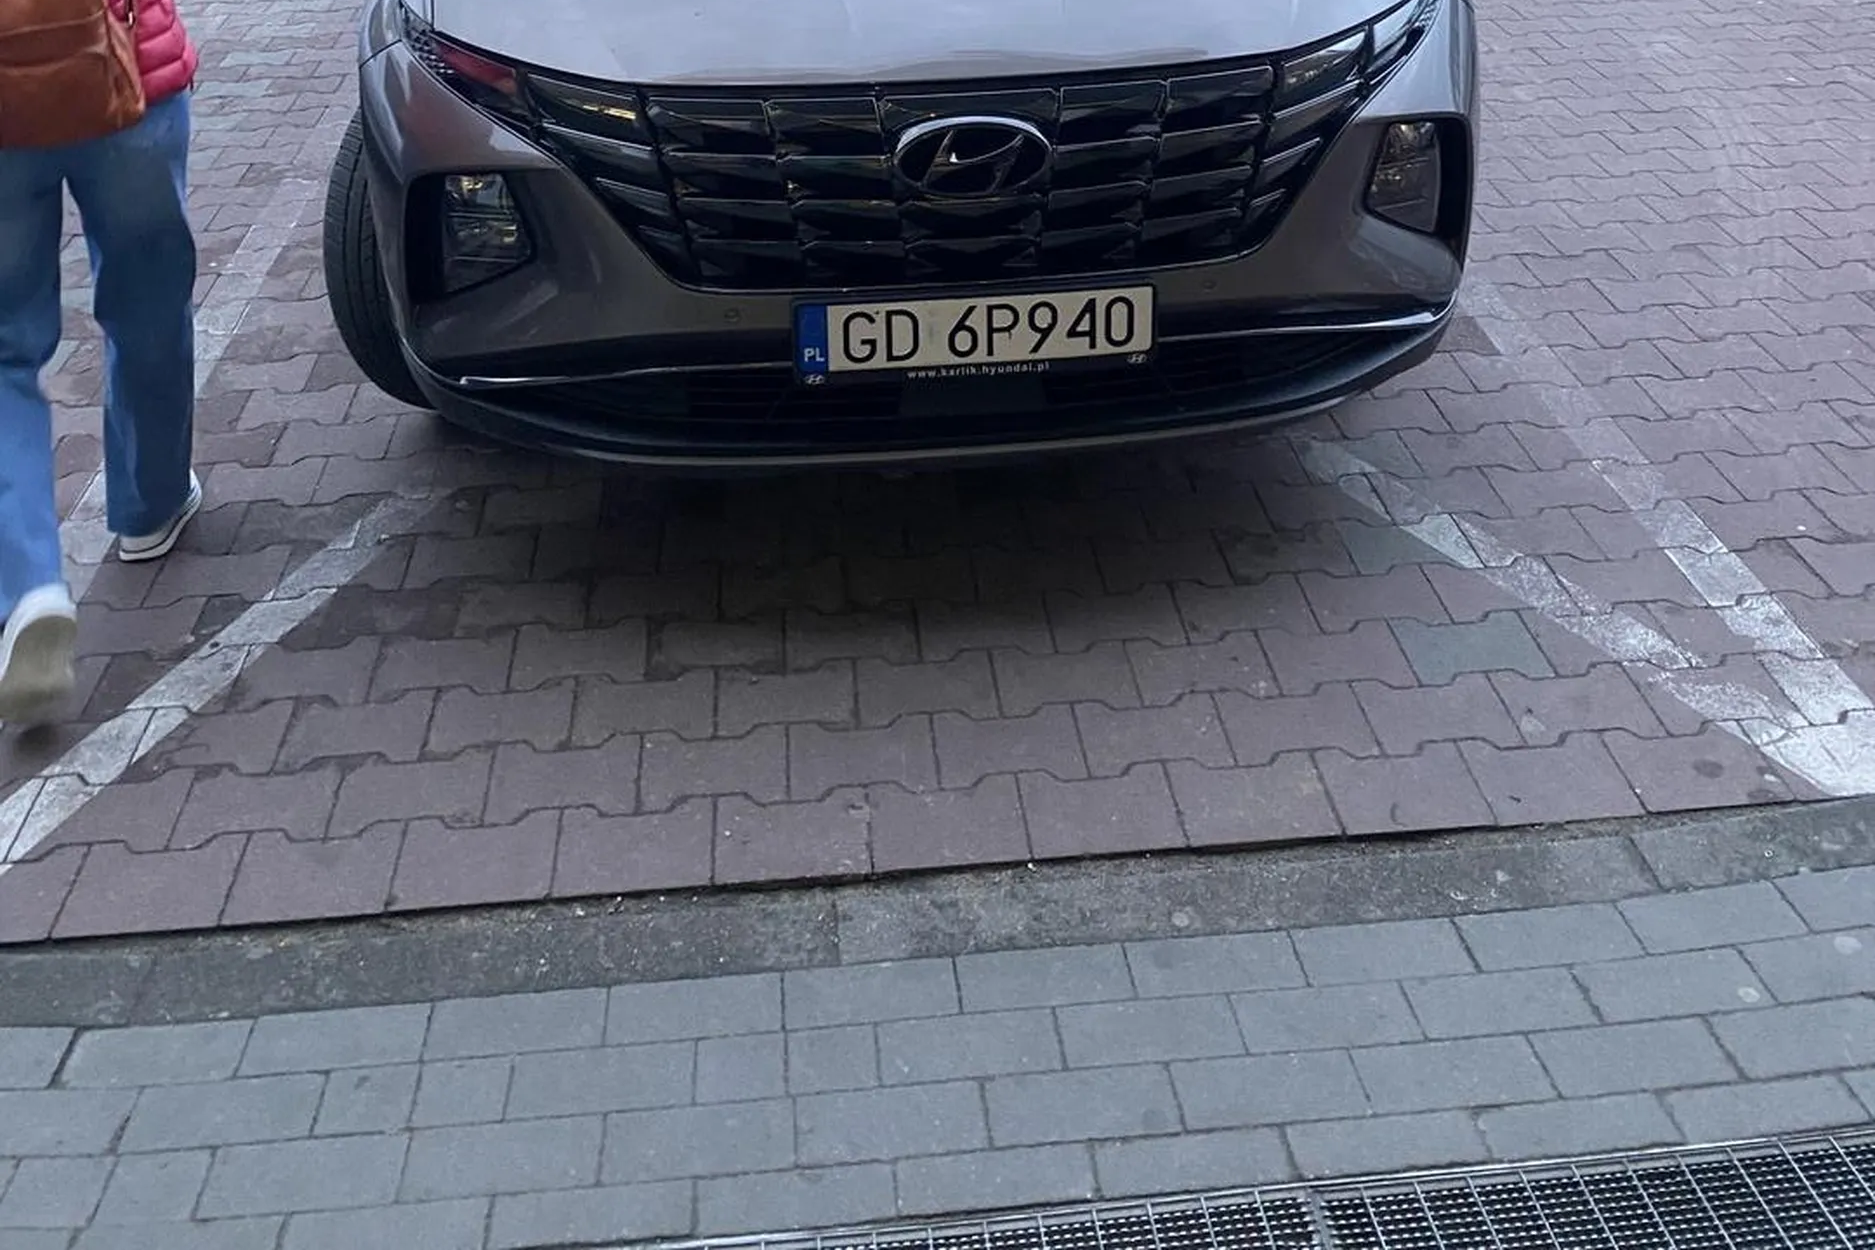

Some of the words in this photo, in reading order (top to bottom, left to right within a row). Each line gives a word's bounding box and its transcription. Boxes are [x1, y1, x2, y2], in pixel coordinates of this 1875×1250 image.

[842, 308, 920, 364] GD
[948, 296, 1135, 358] 6P940
[804, 347, 825, 362] PL
[907, 361, 1050, 378] www.karlik.hyundai.pl
